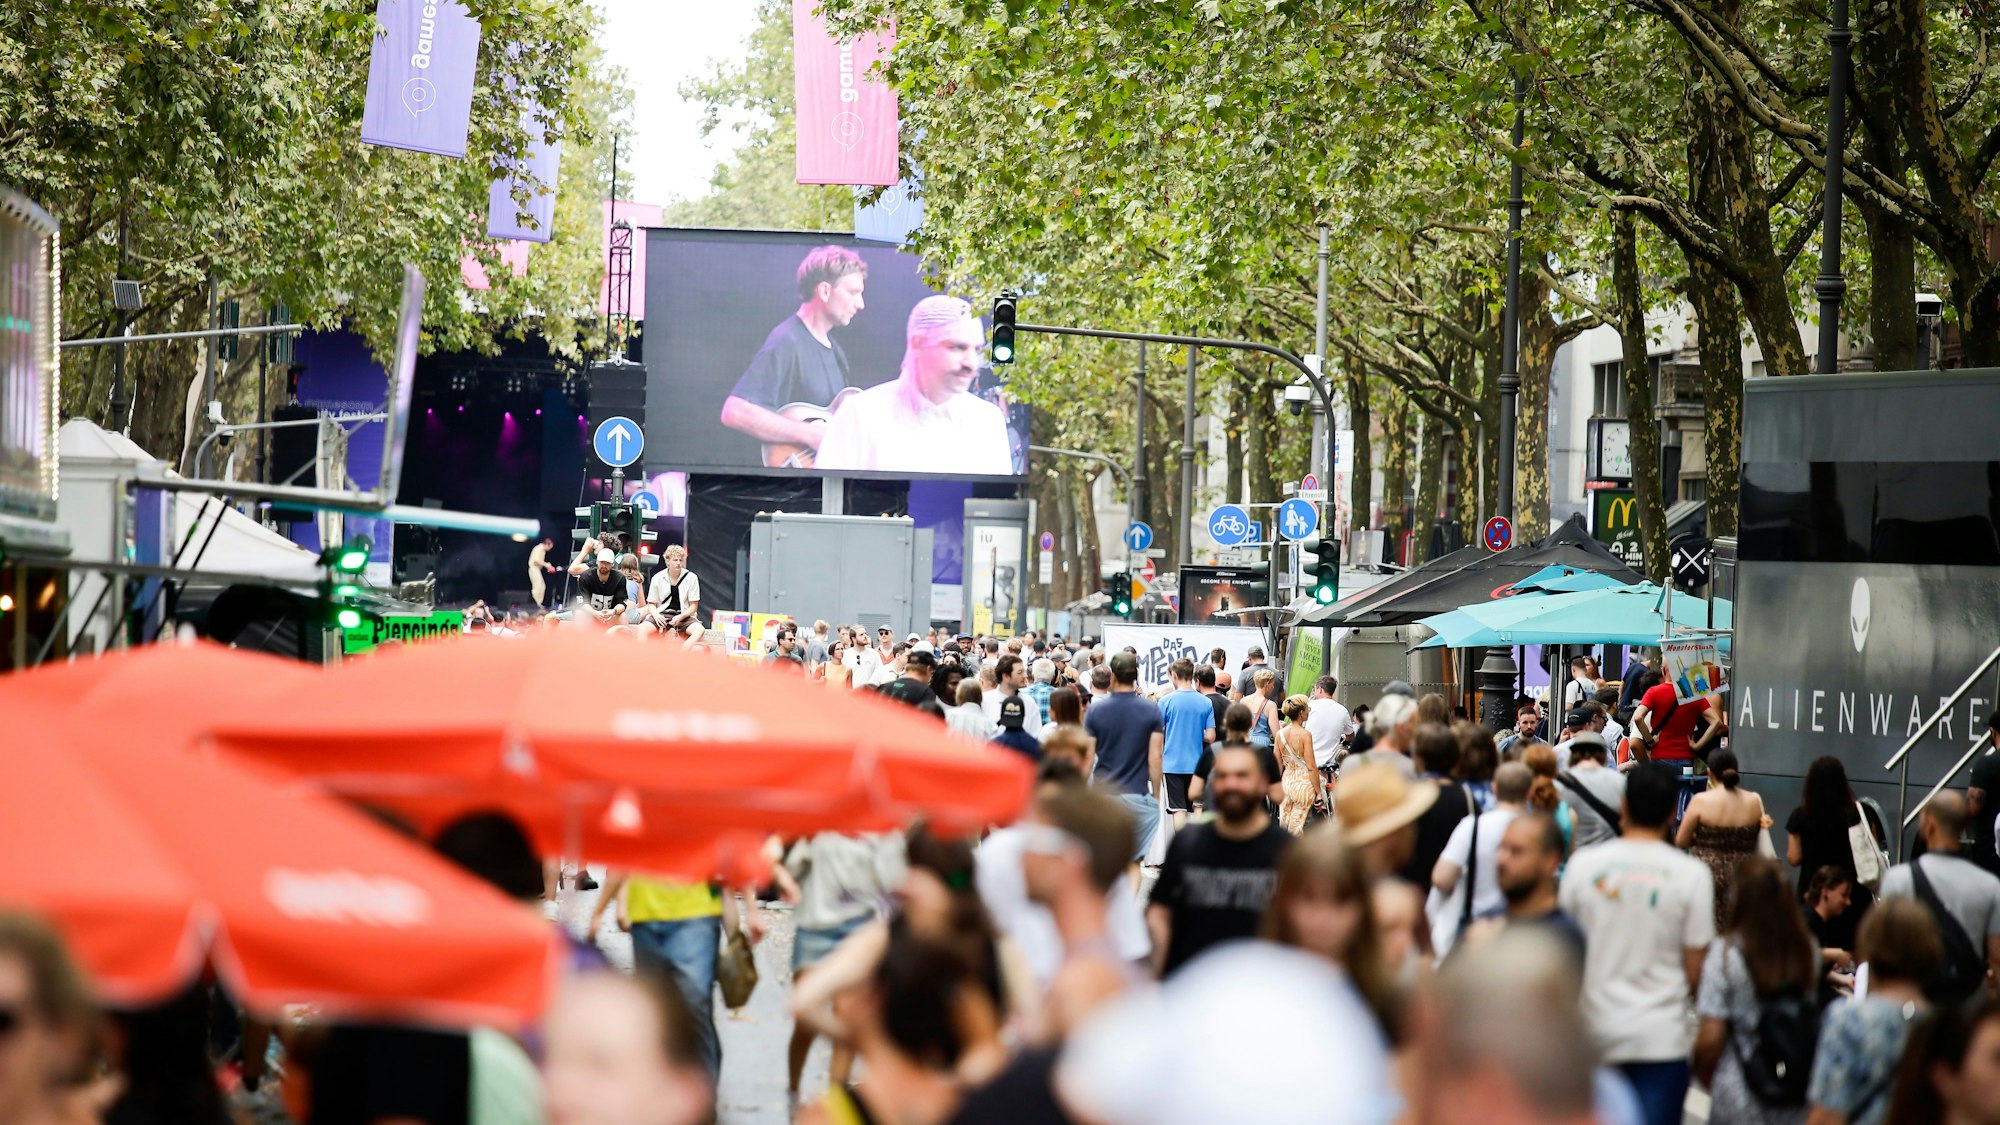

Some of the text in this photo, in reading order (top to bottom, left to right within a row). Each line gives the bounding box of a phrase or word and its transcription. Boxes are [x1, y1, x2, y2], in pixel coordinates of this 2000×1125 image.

[1629, 541, 1638, 552] 2
[1625, 552, 1643, 560] MIN
[1163, 637, 1183, 651] DAS
[1739, 685, 1984, 742] ALIENWARE
